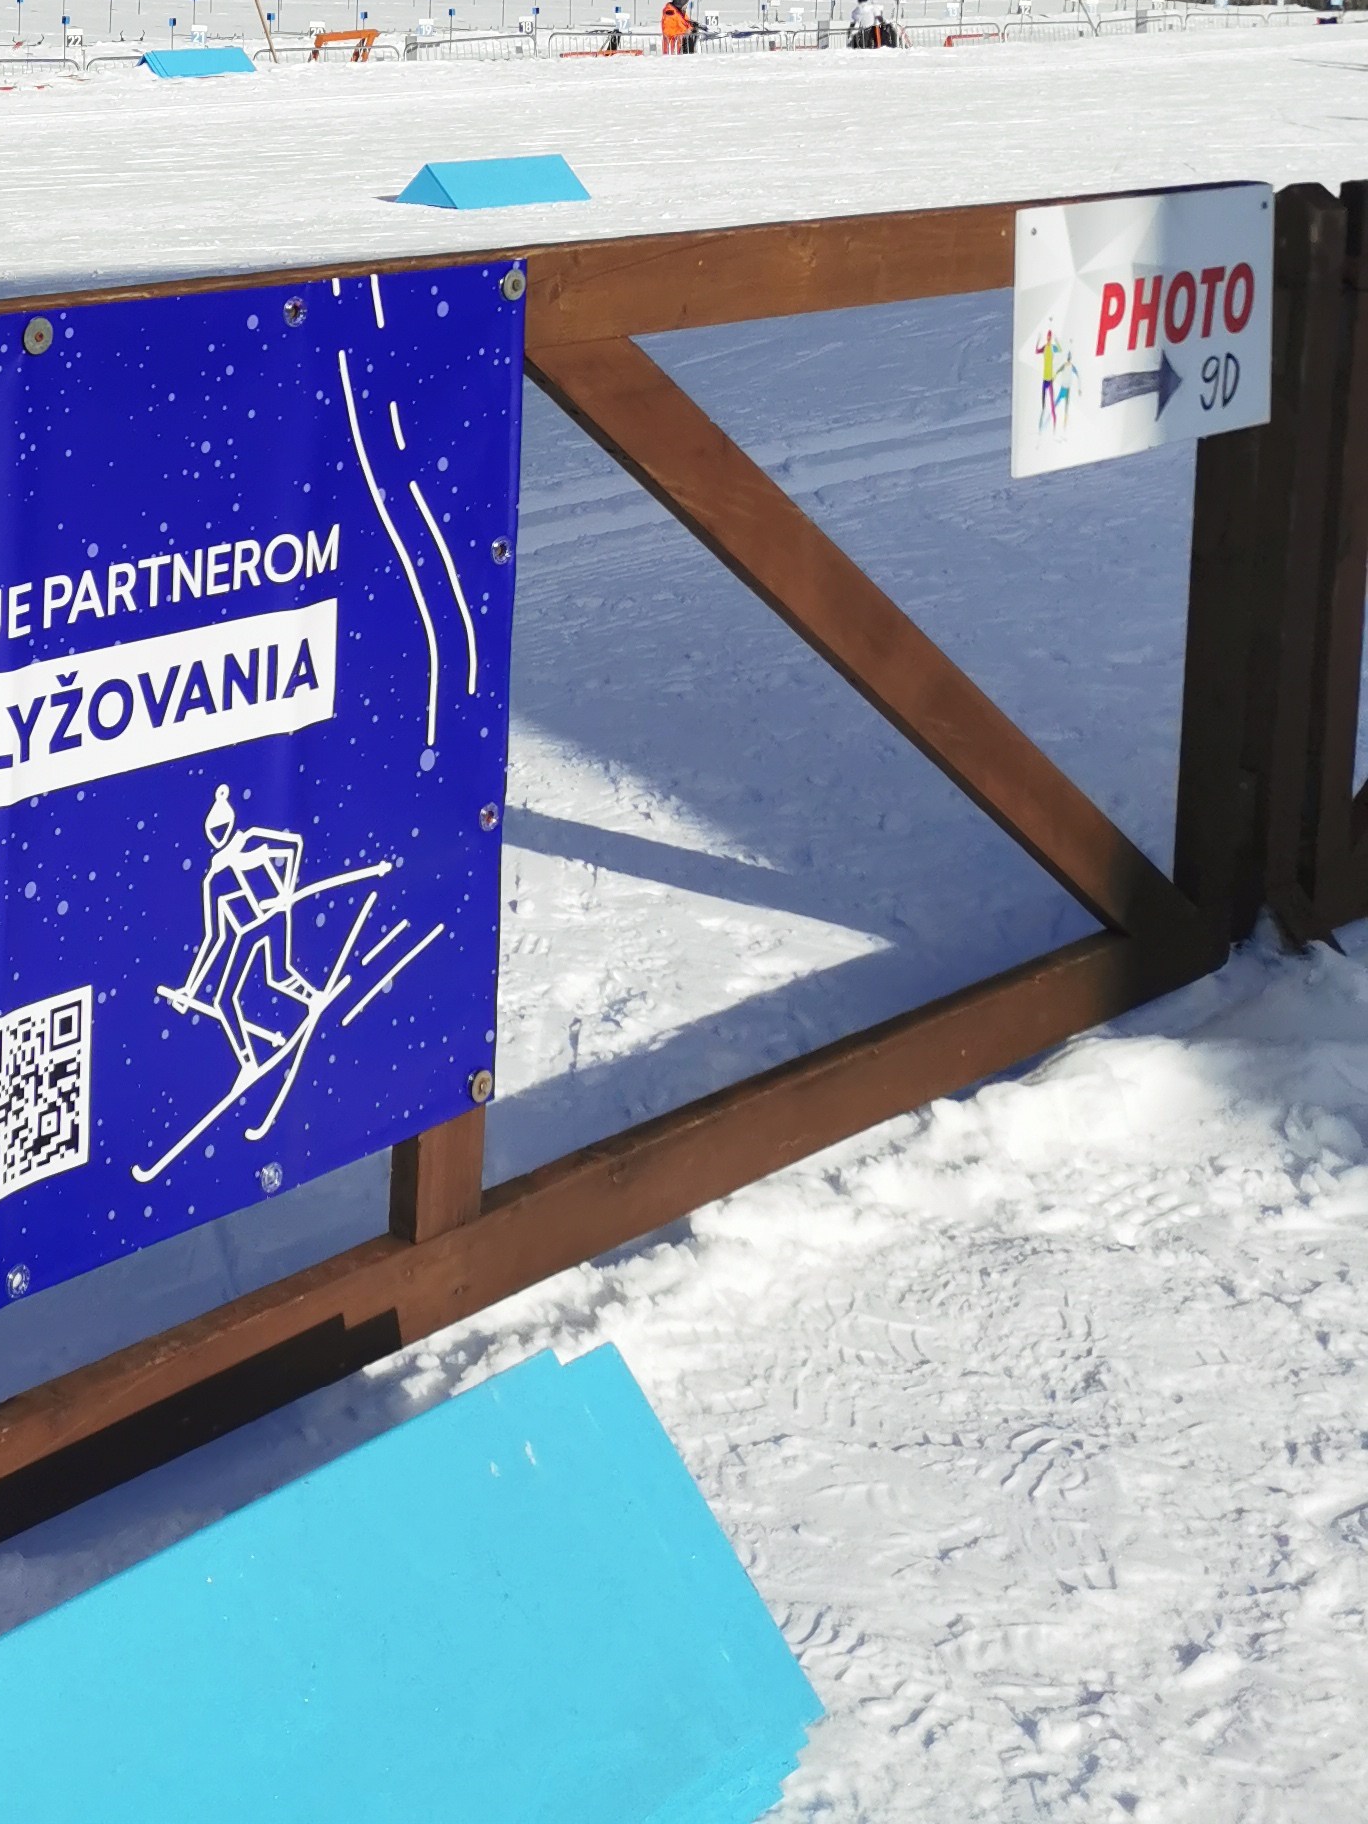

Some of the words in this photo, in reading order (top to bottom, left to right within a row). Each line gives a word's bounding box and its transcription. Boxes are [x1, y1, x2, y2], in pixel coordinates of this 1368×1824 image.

[521, 21, 532, 33] 18
[707, 16, 717, 26] 16
[421, 25, 432, 36] 19
[67, 35, 81, 47] 22
[193, 31, 206, 43] 21
[1095, 262, 1255, 357] PHOTO
[43, 523, 341, 629] PARTNEROM
